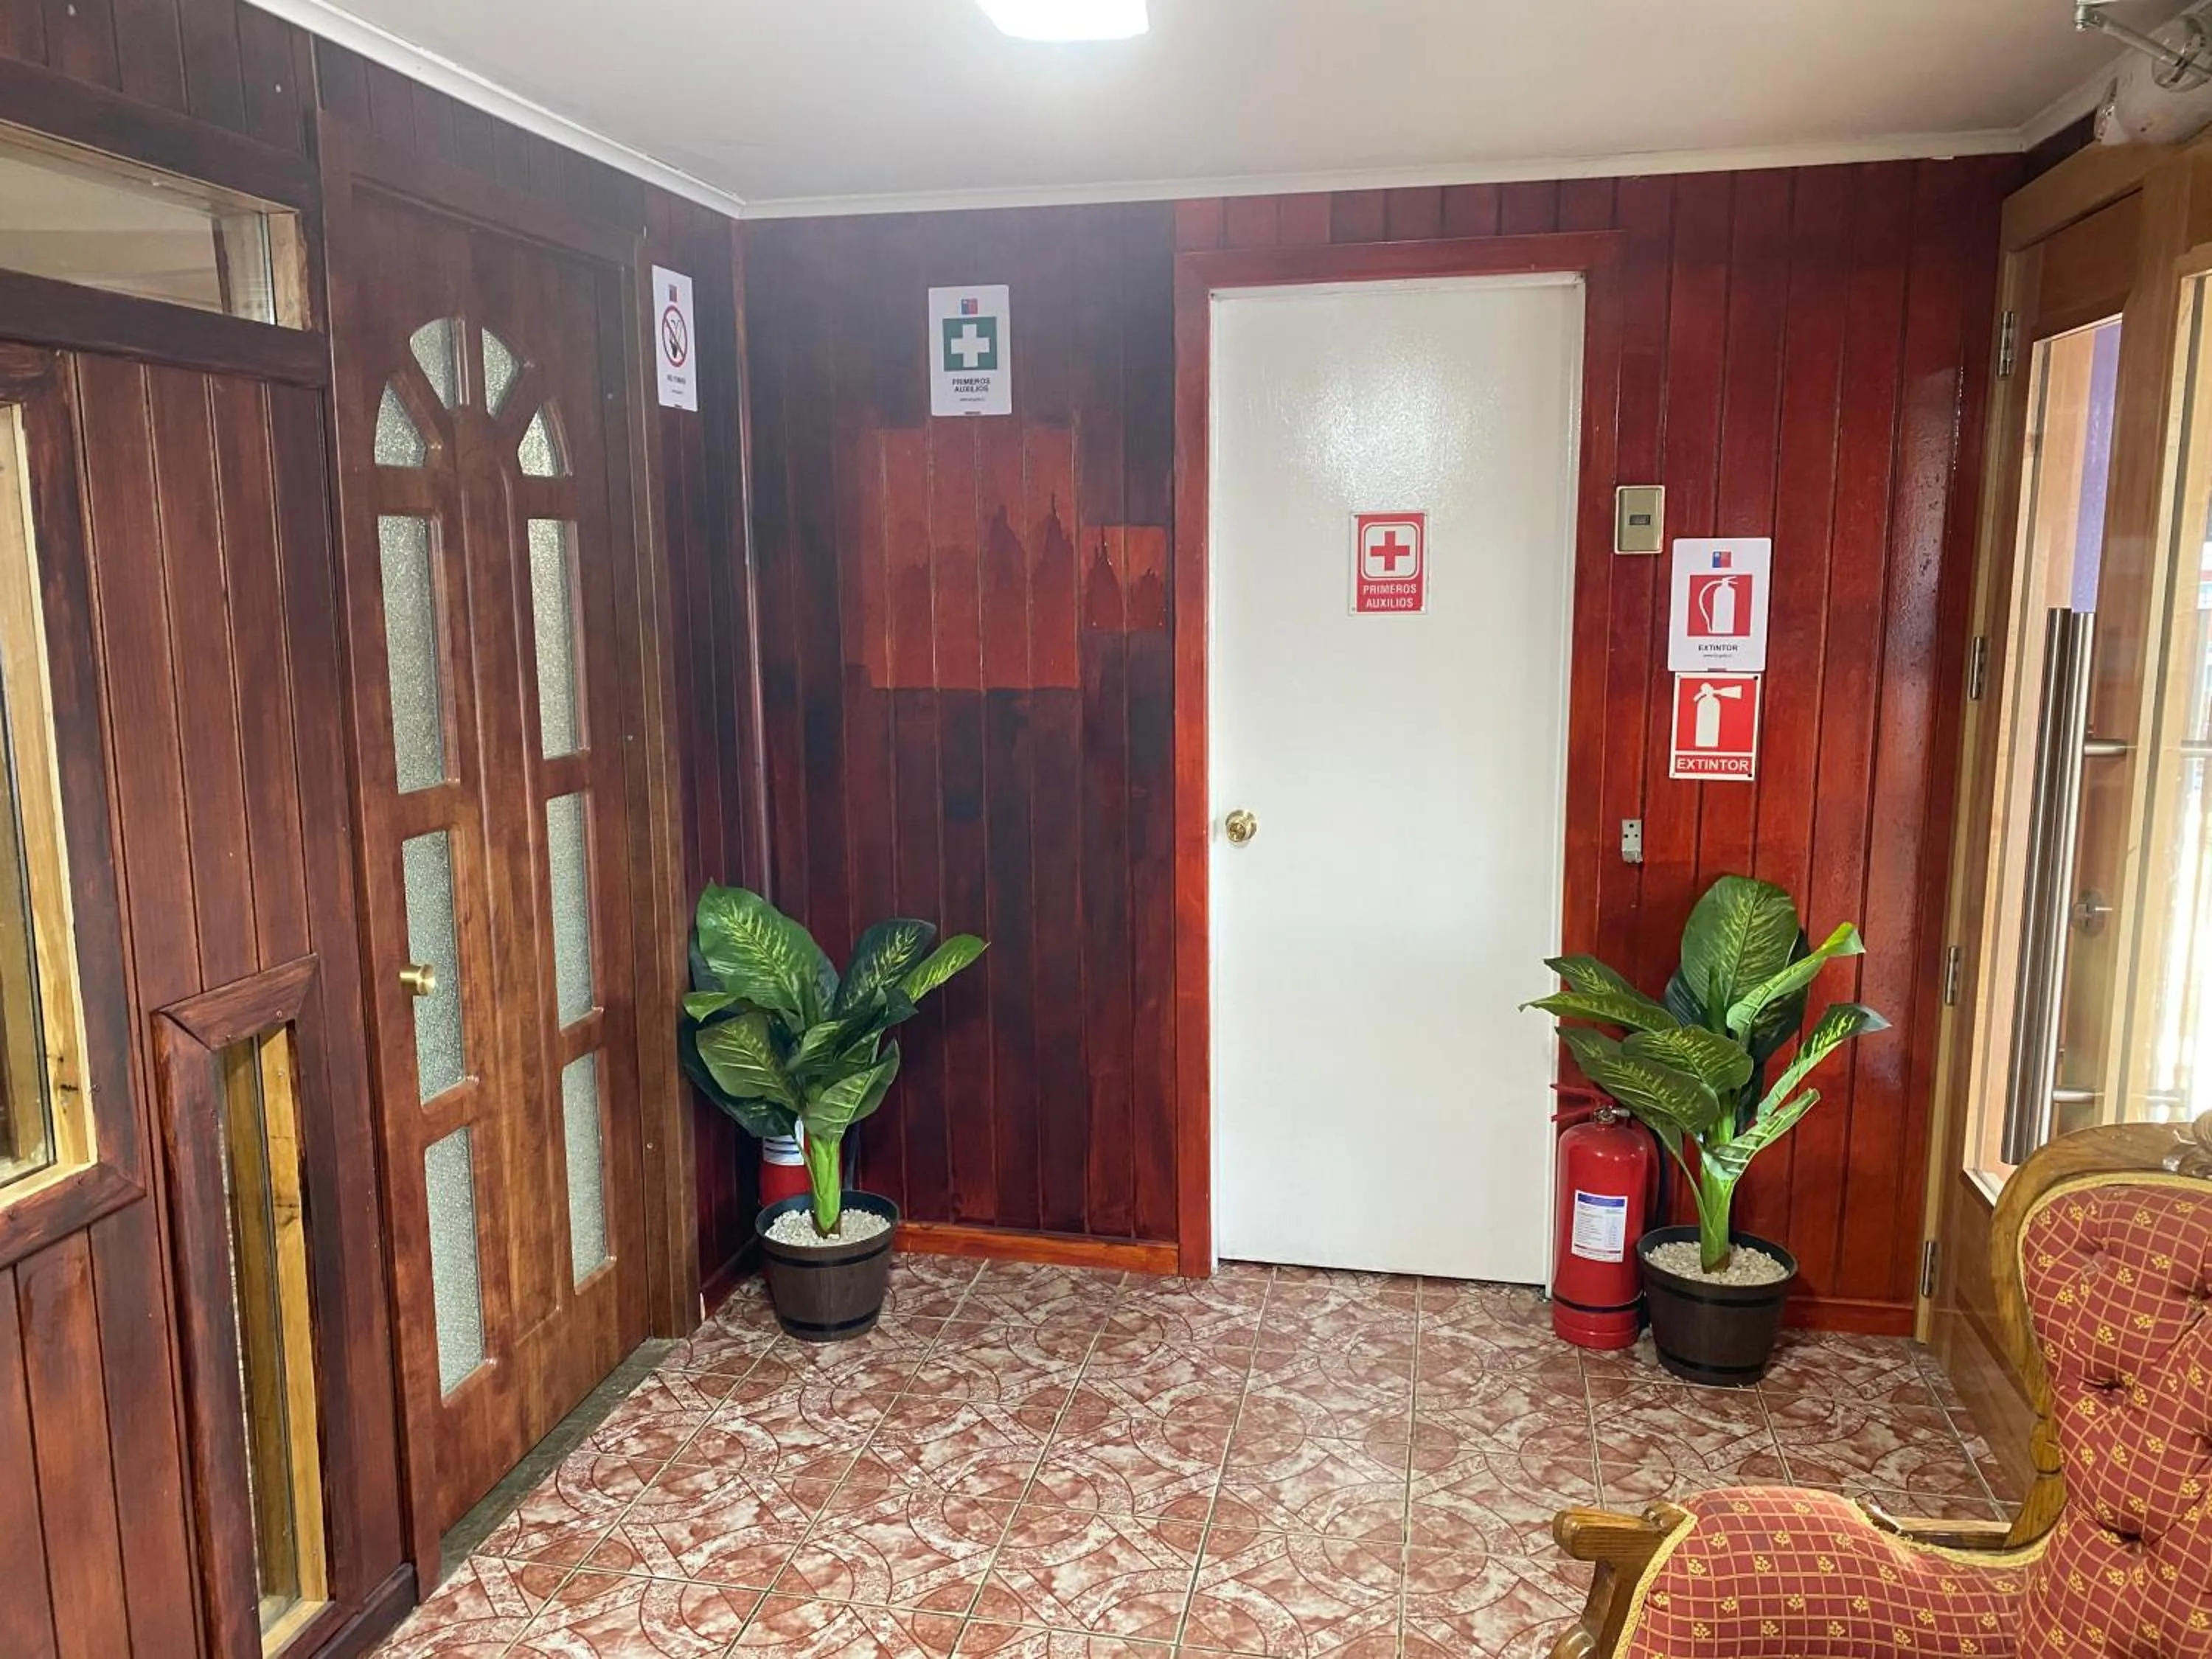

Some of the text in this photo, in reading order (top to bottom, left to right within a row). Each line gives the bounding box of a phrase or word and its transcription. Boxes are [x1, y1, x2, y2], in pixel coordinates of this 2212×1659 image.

[1363, 583, 1416, 594] PRIMEROS
[1366, 596, 1413, 608] AUXILIOS
[1698, 644, 1739, 652] EXTINTOR
[1677, 758, 1749, 771] EXTINTOR
